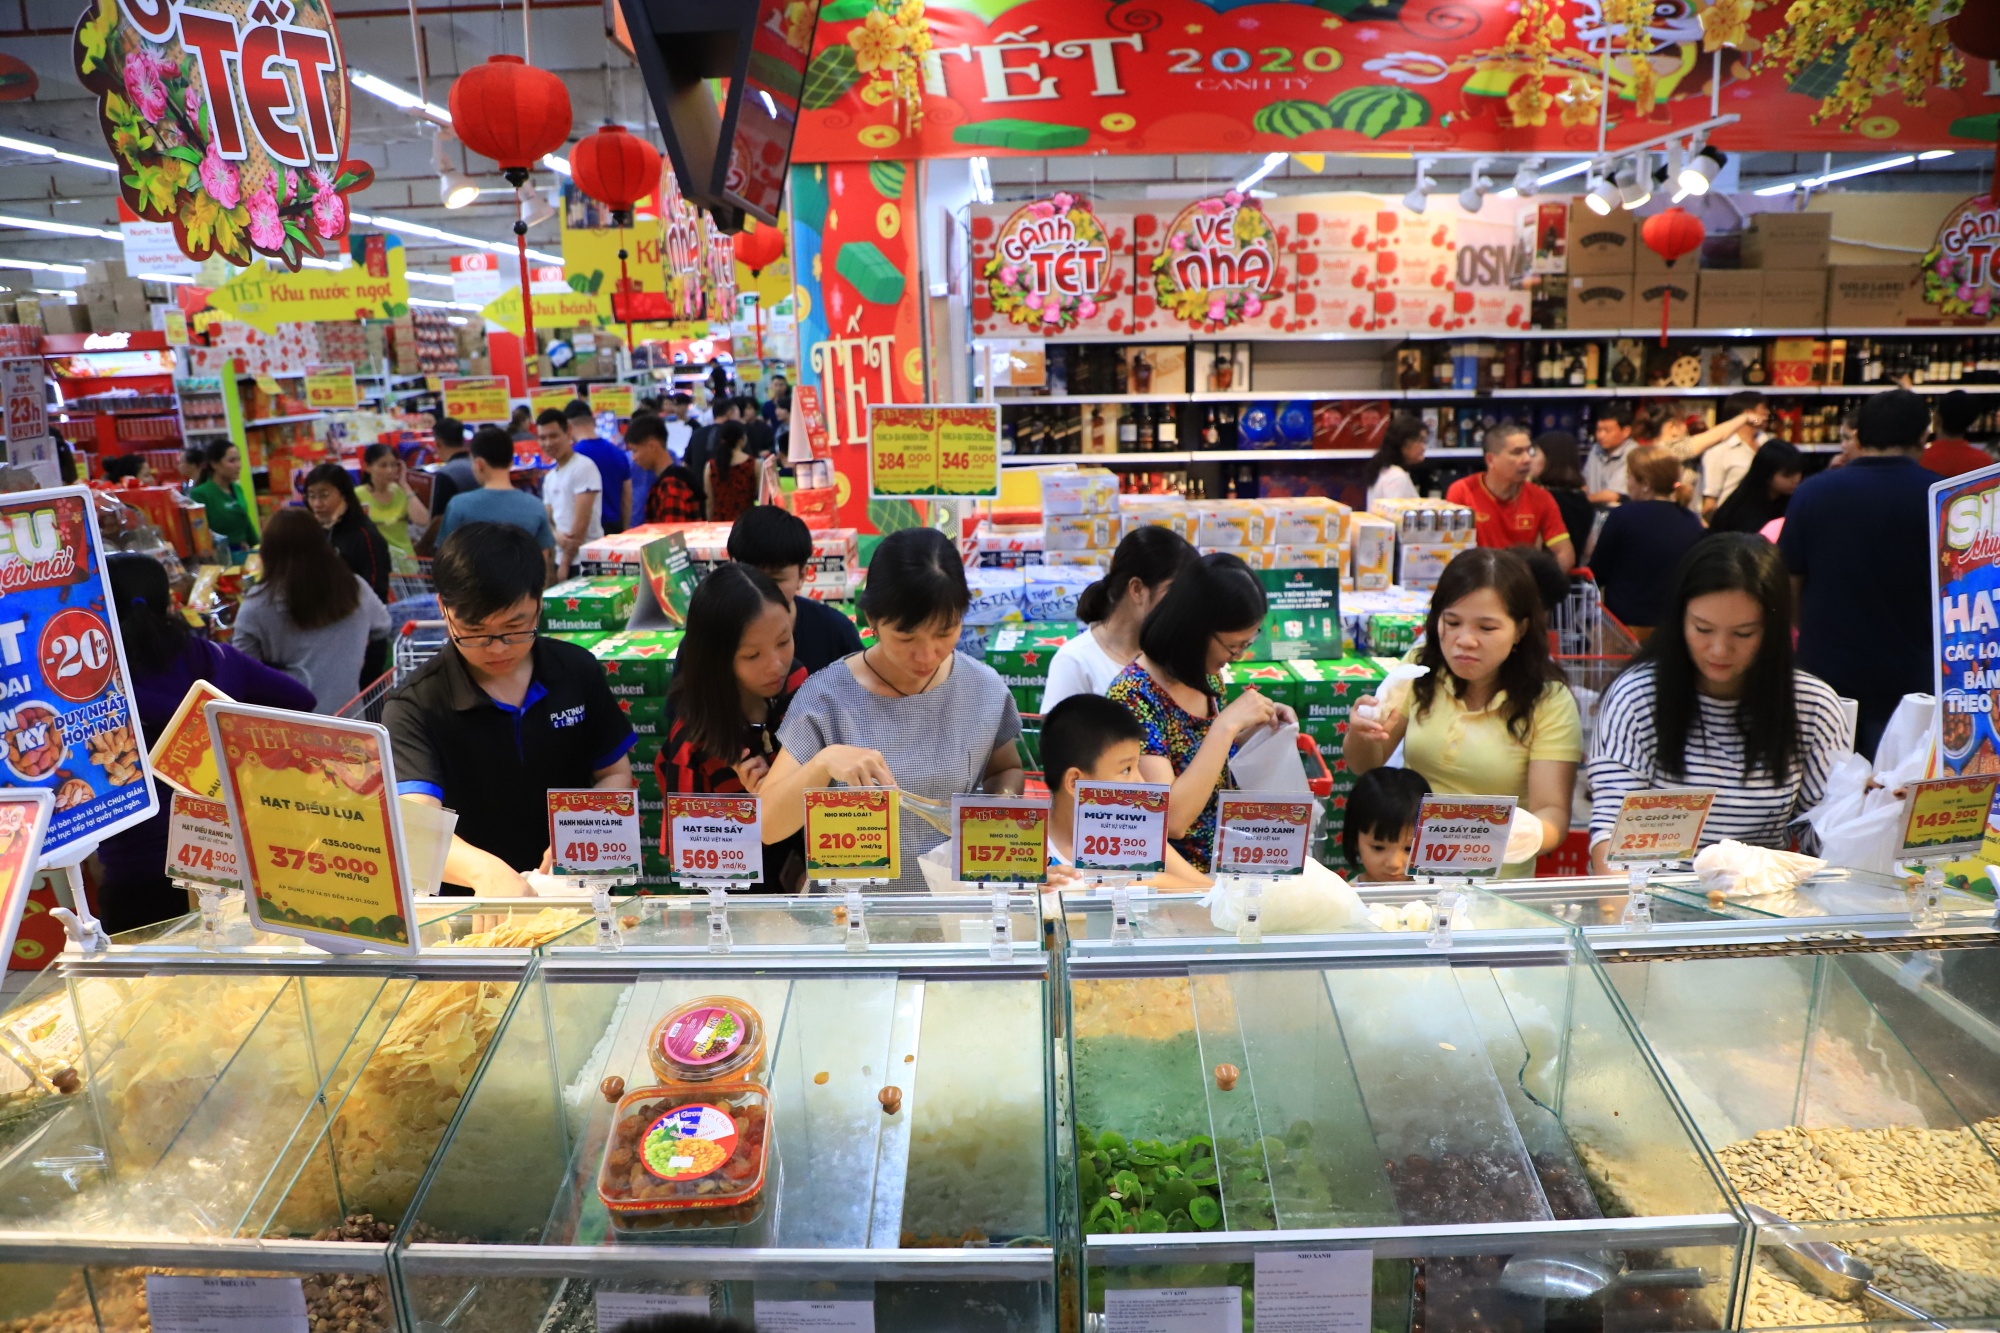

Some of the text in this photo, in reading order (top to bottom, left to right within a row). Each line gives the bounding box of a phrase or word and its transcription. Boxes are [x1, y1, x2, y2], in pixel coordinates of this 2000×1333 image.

[918, 25, 1143, 103] TẾT
[1167, 46, 1343, 75] 2020
[178, 0, 336, 164] TẾT
[1030, 240, 1105, 294] TẾT
[270, 281, 393, 303] Khu nước ngọt
[559, 299, 599, 316] bánh
[810, 305, 896, 447] TẾT
[10, 396, 41, 425] 23h
[11, 422, 43, 440] KHUYA
[878, 451, 932, 470] 384.000
[942, 451, 997, 470] 346.000
[31, 546, 74, 581] mãi
[547, 618, 602, 630] Heineken
[1945, 641, 1975, 662] CÁC
[54, 692, 127, 731] DUY NHẤT
[15, 722, 48, 753] KÝ
[61, 712, 127, 748] HÔM NAY
[243, 721, 333, 750] TẾT 2020
[260, 795, 291, 810] HẠT
[333, 807, 365, 822] LỤA
[562, 793, 589, 805] TẾT
[681, 799, 710, 811] TẾT
[1084, 811, 1147, 822] MỨT KIWI
[1916, 809, 1978, 829] 149.900
[208, 830, 224, 838] RANG
[682, 825, 702, 834] HẠT
[724, 824, 744, 834] SẤY
[1428, 825, 1448, 833] TÁO
[321, 838, 381, 854] 435.000vnd
[818, 832, 882, 850] 210.000
[1083, 835, 1147, 856] 203.900
[1620, 832, 1681, 850] 231.900
[177, 843, 237, 871] 474.900
[268, 844, 379, 876] 375.000
[564, 841, 627, 863] 419.900
[602, 854, 632, 862] vnd/Kg
[682, 848, 744, 870] 569.900
[967, 845, 1035, 862] 157.900
[1123, 849, 1148, 857] vnd/Kg
[1232, 846, 1289, 864] 199.900
[1425, 843, 1491, 862] 107.900
[1463, 855, 1493, 863] vnd/Kg
[722, 861, 747, 871] vnd/Kg
[334, 871, 370, 884] vnd/kg
[1312, 1252, 1332, 1260] XANH
